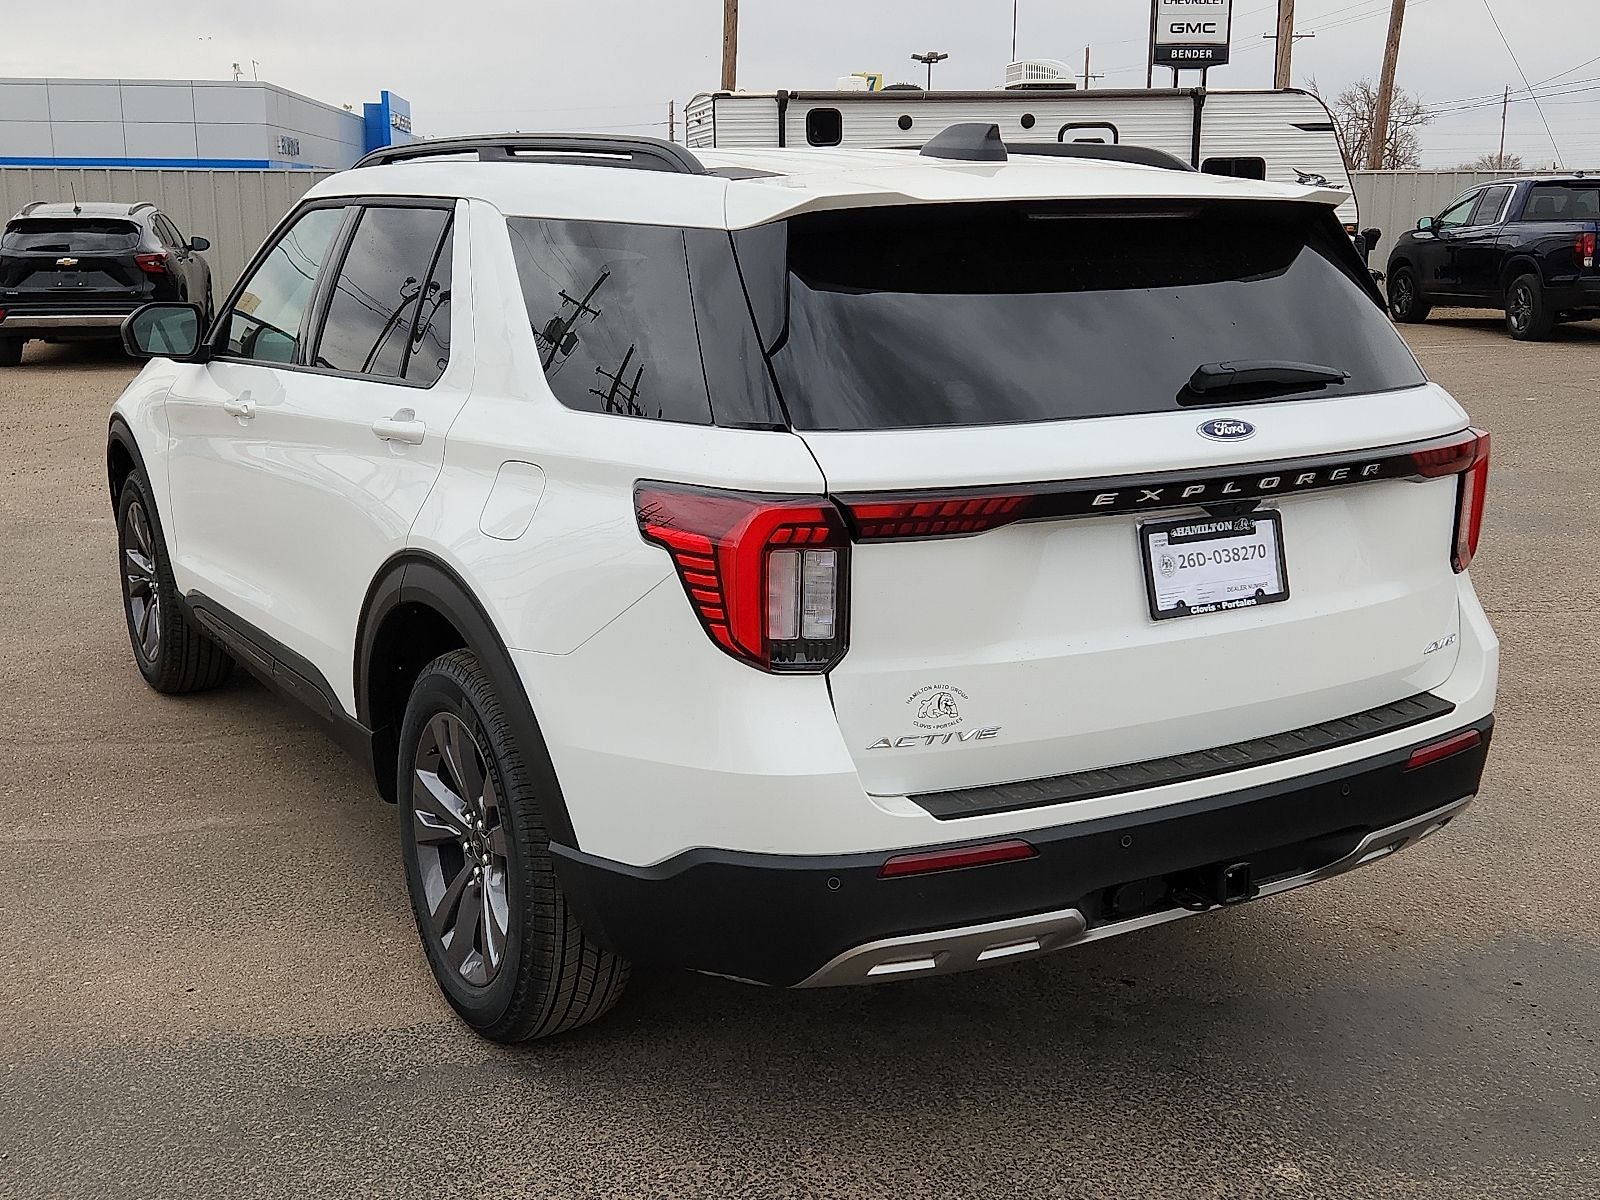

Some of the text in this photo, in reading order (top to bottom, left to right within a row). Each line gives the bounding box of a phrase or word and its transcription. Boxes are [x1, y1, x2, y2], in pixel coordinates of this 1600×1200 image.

[1170, 23, 1216, 34] GMC
[1171, 49, 1213, 59] BENDER
[1213, 420, 1247, 436] Ford
[1091, 463, 1381, 506] EXPLORER
[1175, 521, 1233, 537] HAMILTON
[1178, 544, 1267, 569] 26D-038270
[1190, 604, 1216, 614] Clovis
[906, 685, 932, 704] HAMILTON
[950, 686, 968, 700] GROUP
[866, 727, 1002, 750] ACTIVE
